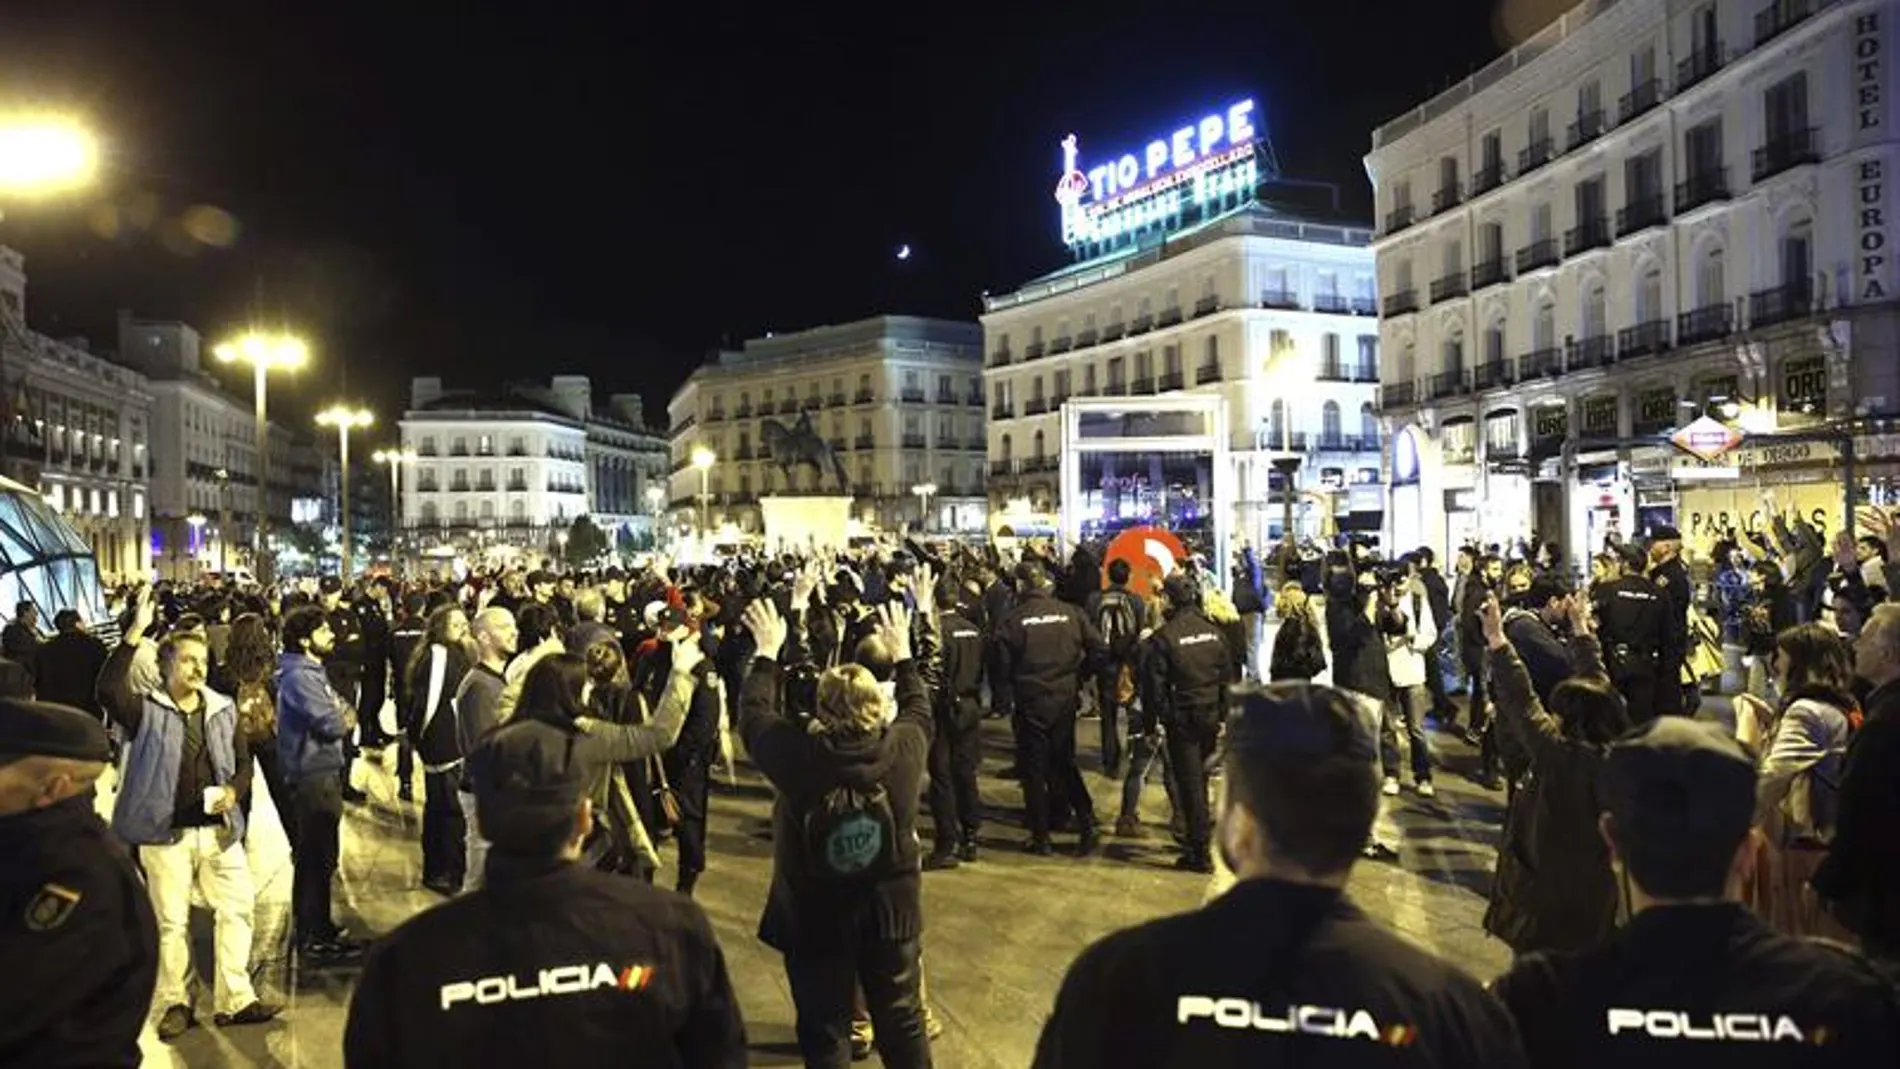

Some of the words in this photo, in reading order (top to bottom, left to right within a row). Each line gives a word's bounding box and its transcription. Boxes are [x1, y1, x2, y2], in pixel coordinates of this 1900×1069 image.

[1857, 14, 1880, 130] HOTEL
[1088, 153, 1139, 201] TIO
[1146, 98, 1254, 177] PEPE
[1860, 160, 1885, 299] EUROPA
[1787, 371, 1827, 399] ORO
[1691, 508, 1827, 535] PARGS
[833, 824, 876, 855] STOP
[440, 961, 619, 1010] POLICIA
[1177, 995, 1381, 1041] POLICIA
[1607, 1008, 1804, 1042] POLICIA
